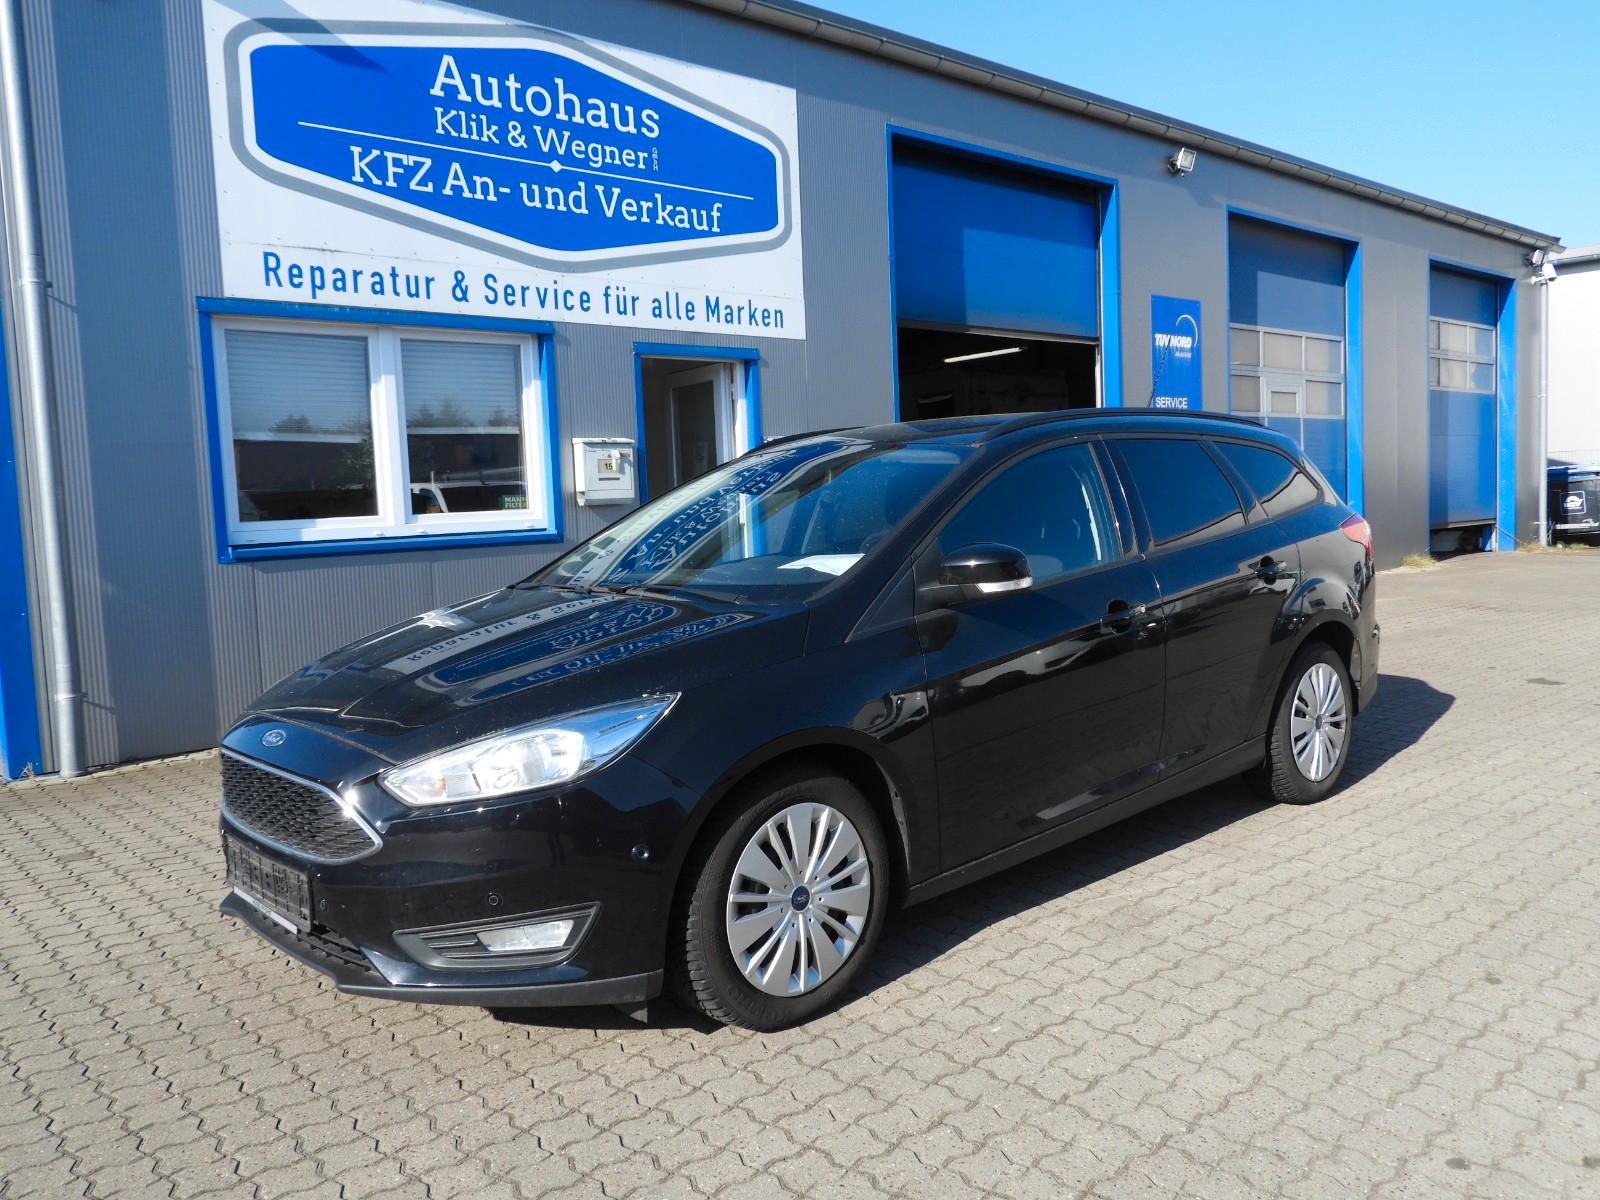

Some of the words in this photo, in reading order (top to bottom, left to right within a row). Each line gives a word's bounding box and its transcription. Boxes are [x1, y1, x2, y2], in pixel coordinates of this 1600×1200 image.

[429, 54, 660, 138] Autohaus
[434, 106, 500, 144] Klik
[507, 120, 528, 149] &
[532, 125, 648, 169] Wegner
[349, 145, 434, 193] KFZ
[442, 162, 511, 202] An-
[519, 181, 589, 215] und
[594, 184, 723, 233] Verkauf
[262, 250, 435, 301] Reparatur
[450, 270, 470, 304] &
[482, 272, 592, 313] Service
[603, 286, 640, 317] für
[651, 290, 697, 322] alle
[704, 295, 785, 328] Marken
[1170, 336, 1192, 348] NORD
[1156, 397, 1188, 408] SERVICE
